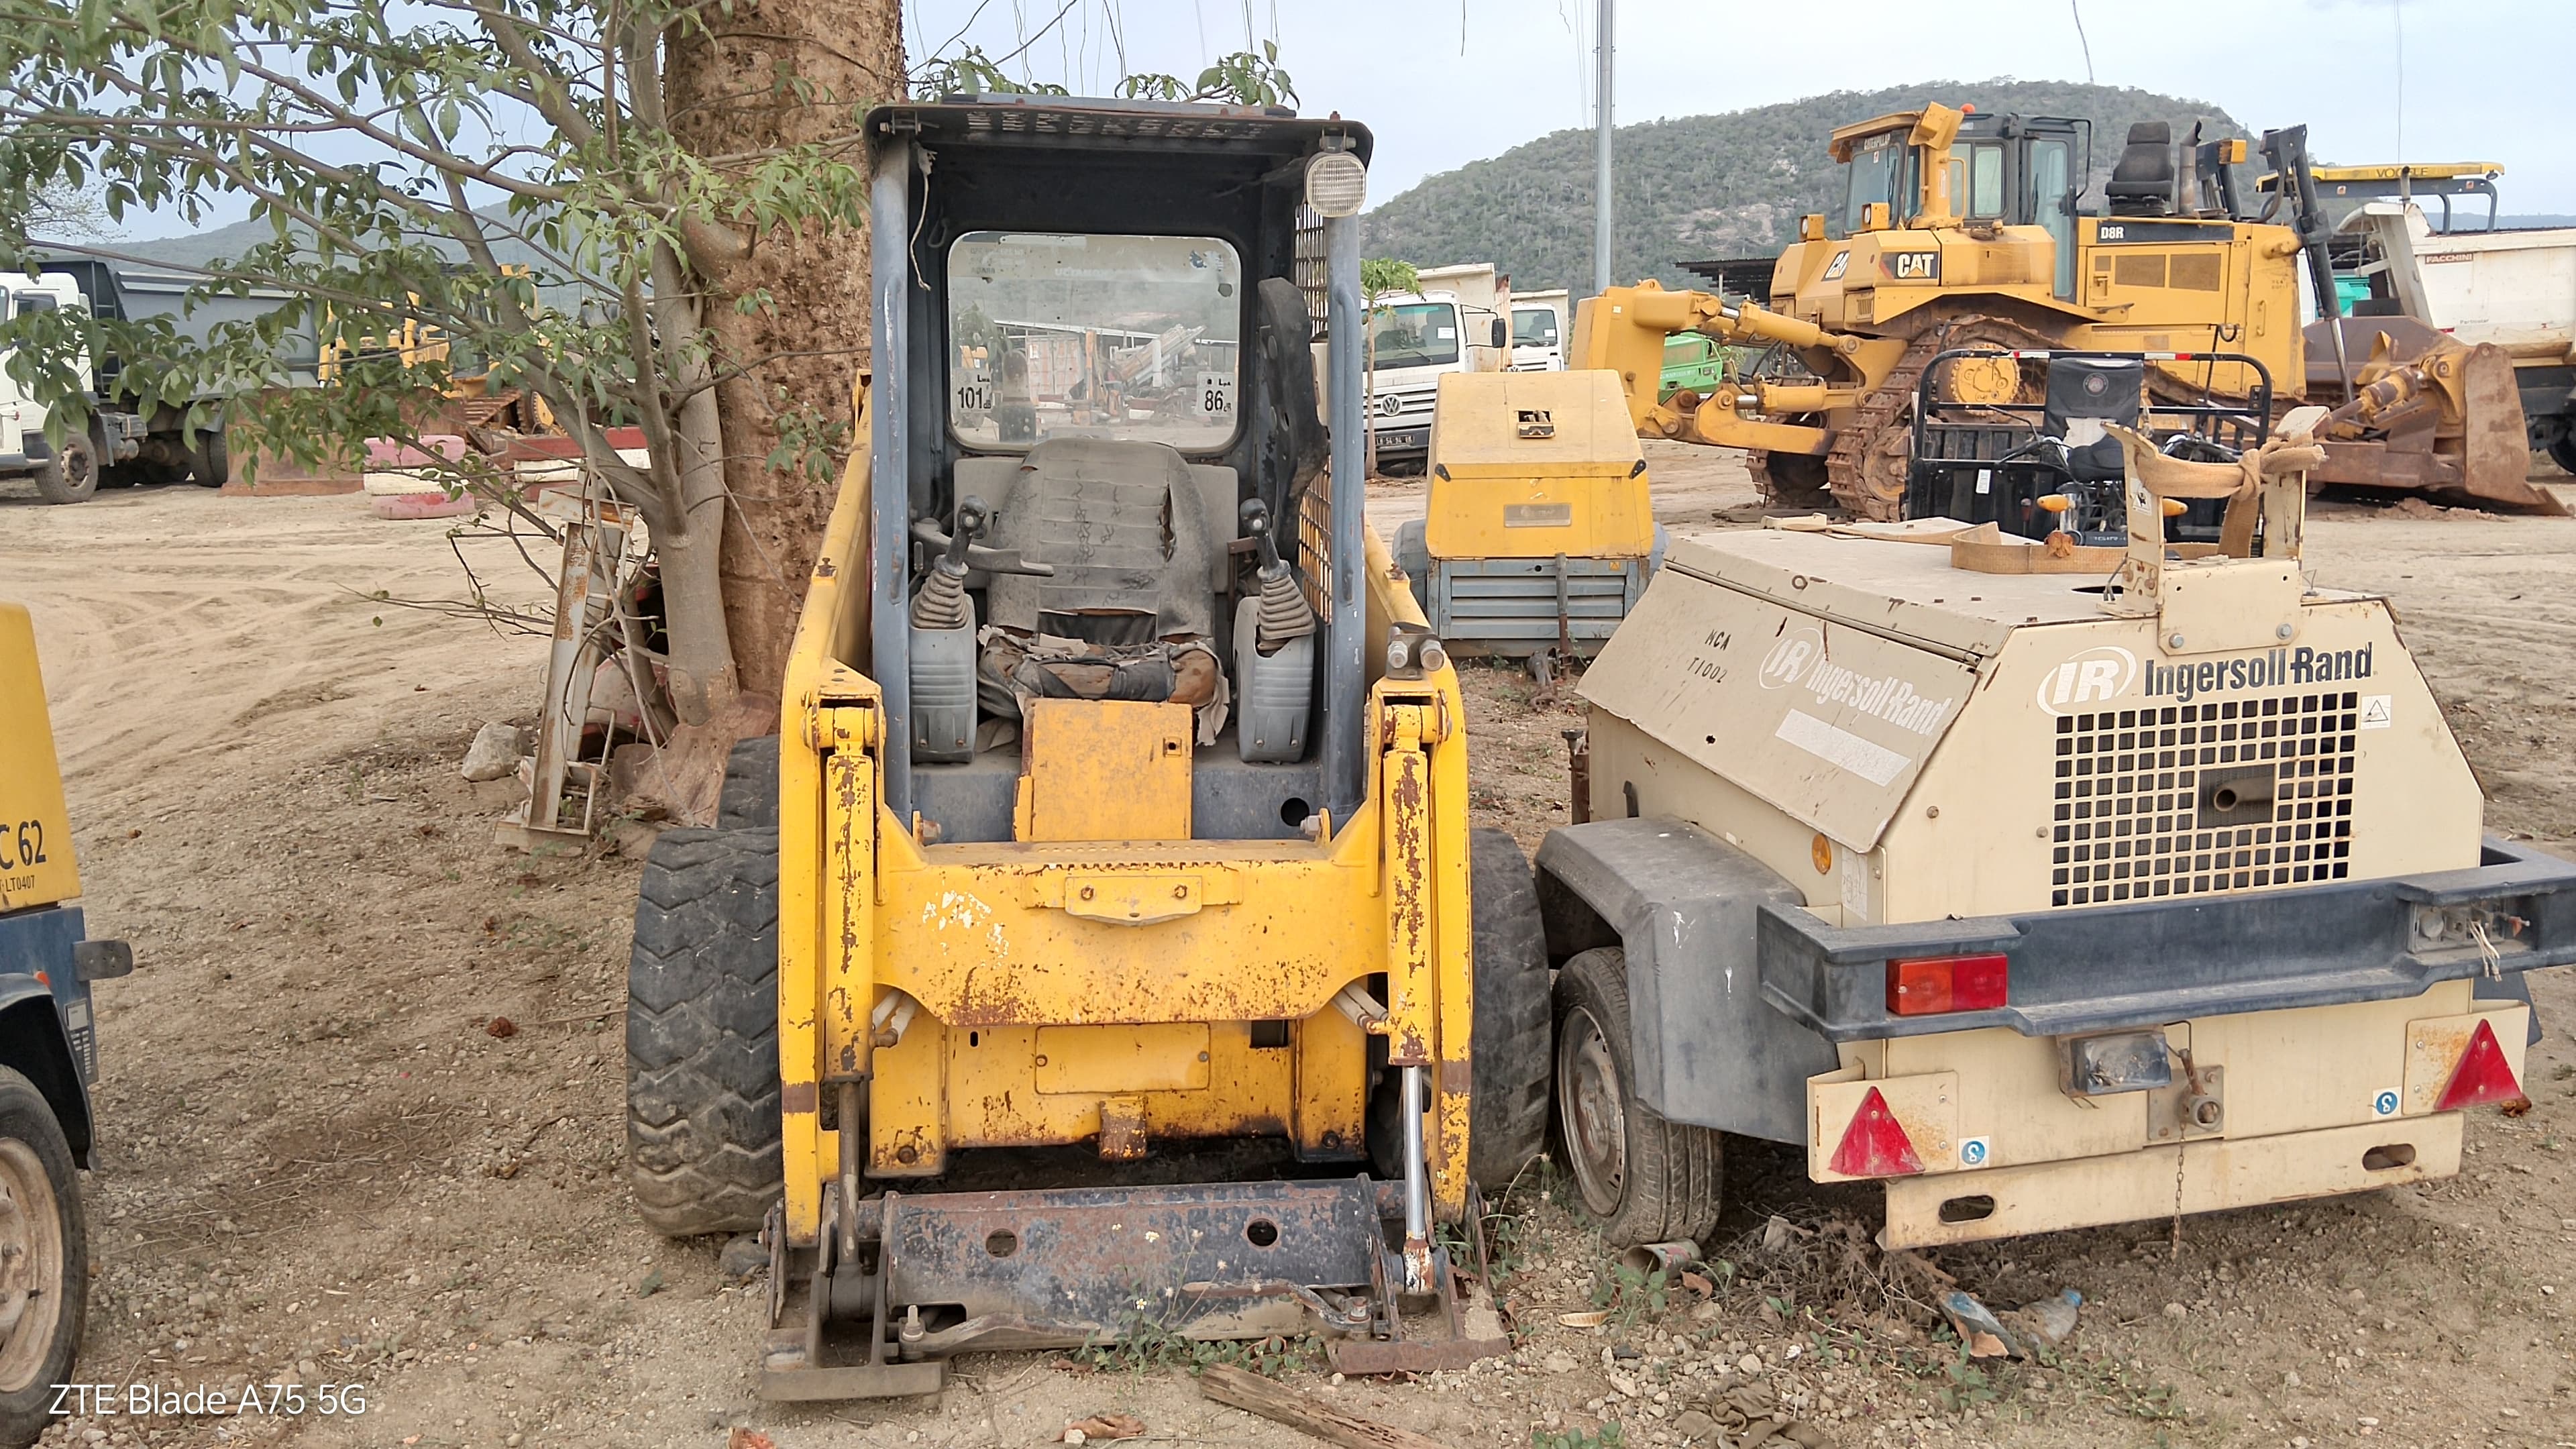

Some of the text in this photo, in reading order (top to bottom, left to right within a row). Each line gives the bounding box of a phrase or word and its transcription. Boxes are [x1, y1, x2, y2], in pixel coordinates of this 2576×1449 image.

[2100, 227, 2125, 239] D8R
[1898, 254, 1934, 278] CAT
[2426, 254, 2473, 264] FACCHINI
[1383, 396, 1400, 415] VW
[1765, 638, 1811, 683] IR
[2053, 660, 2119, 704] IR
[18, 820, 46, 866] 62
